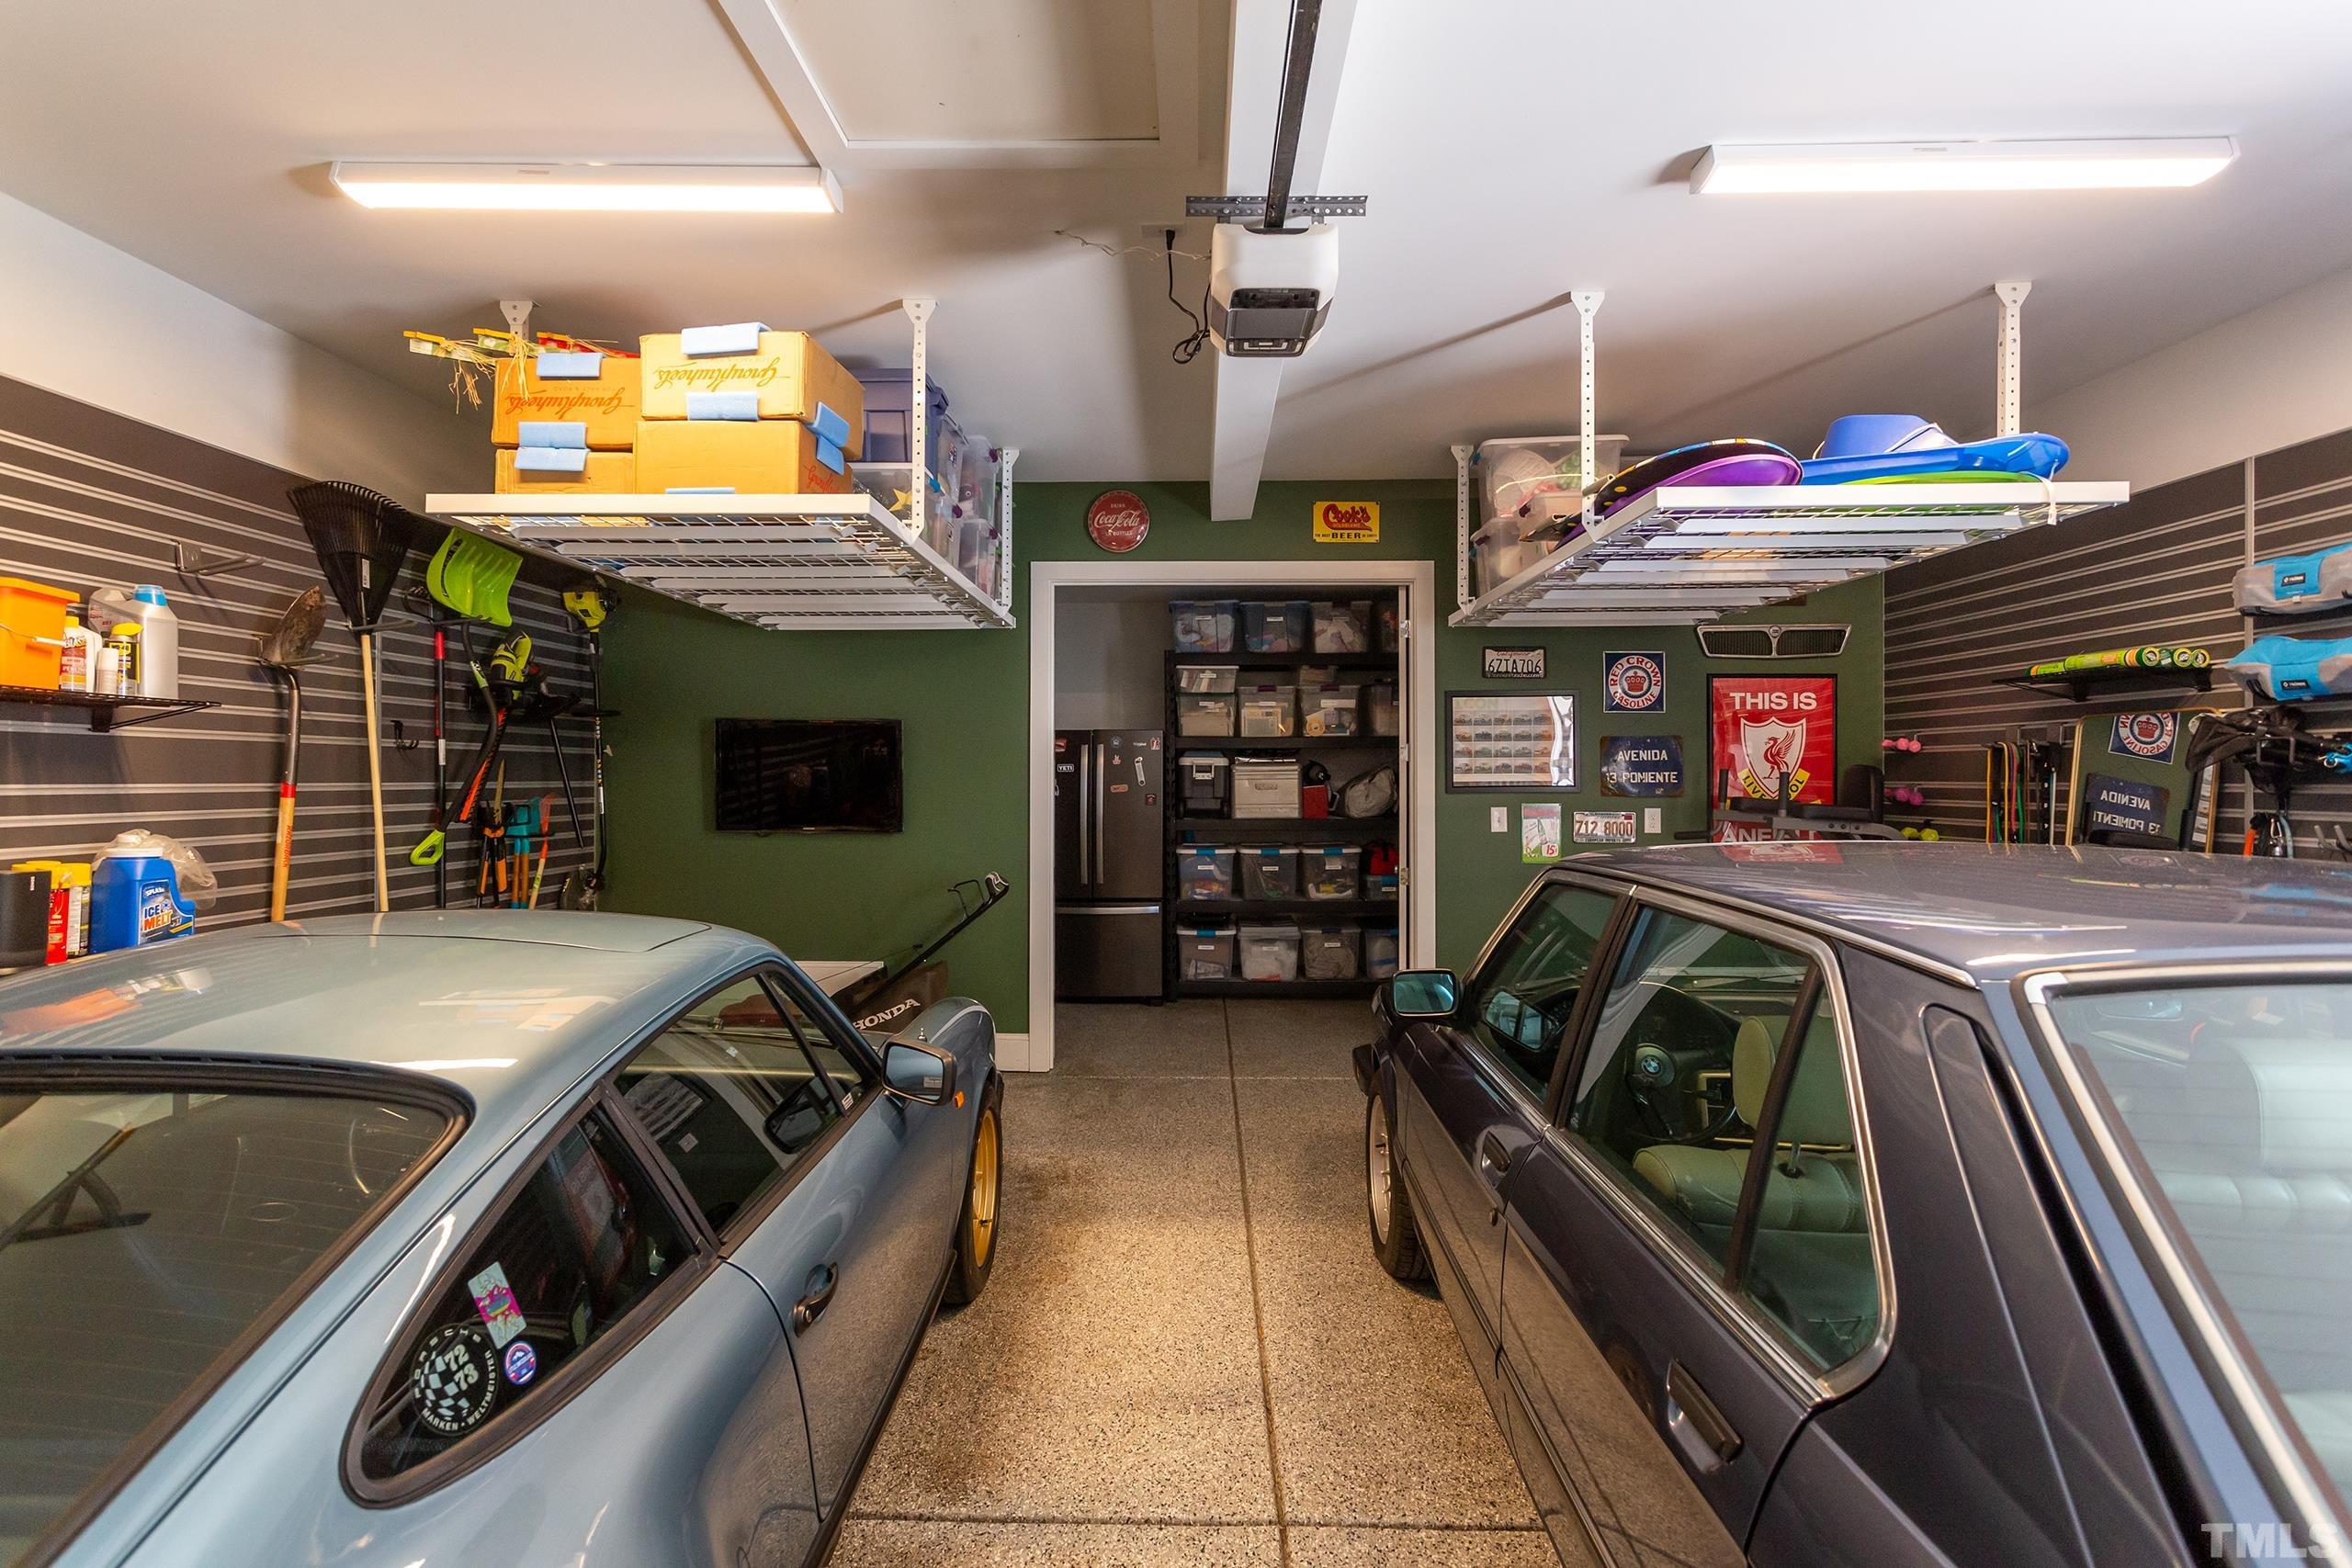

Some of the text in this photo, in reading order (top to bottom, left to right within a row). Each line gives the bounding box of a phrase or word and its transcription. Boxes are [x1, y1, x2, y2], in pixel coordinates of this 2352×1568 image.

[1610, 656, 1661, 687] RED CROWN
[1612, 691, 1657, 708] GASOLINE
[1729, 692, 1817, 710] THIS IS
[1617, 749, 1668, 761] AVENIDA
[1575, 820, 1634, 837] 712 8000
[143, 910, 173, 931] MELT
[144, 904, 161, 919] ICE
[852, 998, 921, 1031] HONDA
[444, 1344, 470, 1371] 72
[453, 1362, 480, 1392] 73
[421, 1407, 458, 1431] MARKEN
[466, 1349, 497, 1426] WELTMEISTER
